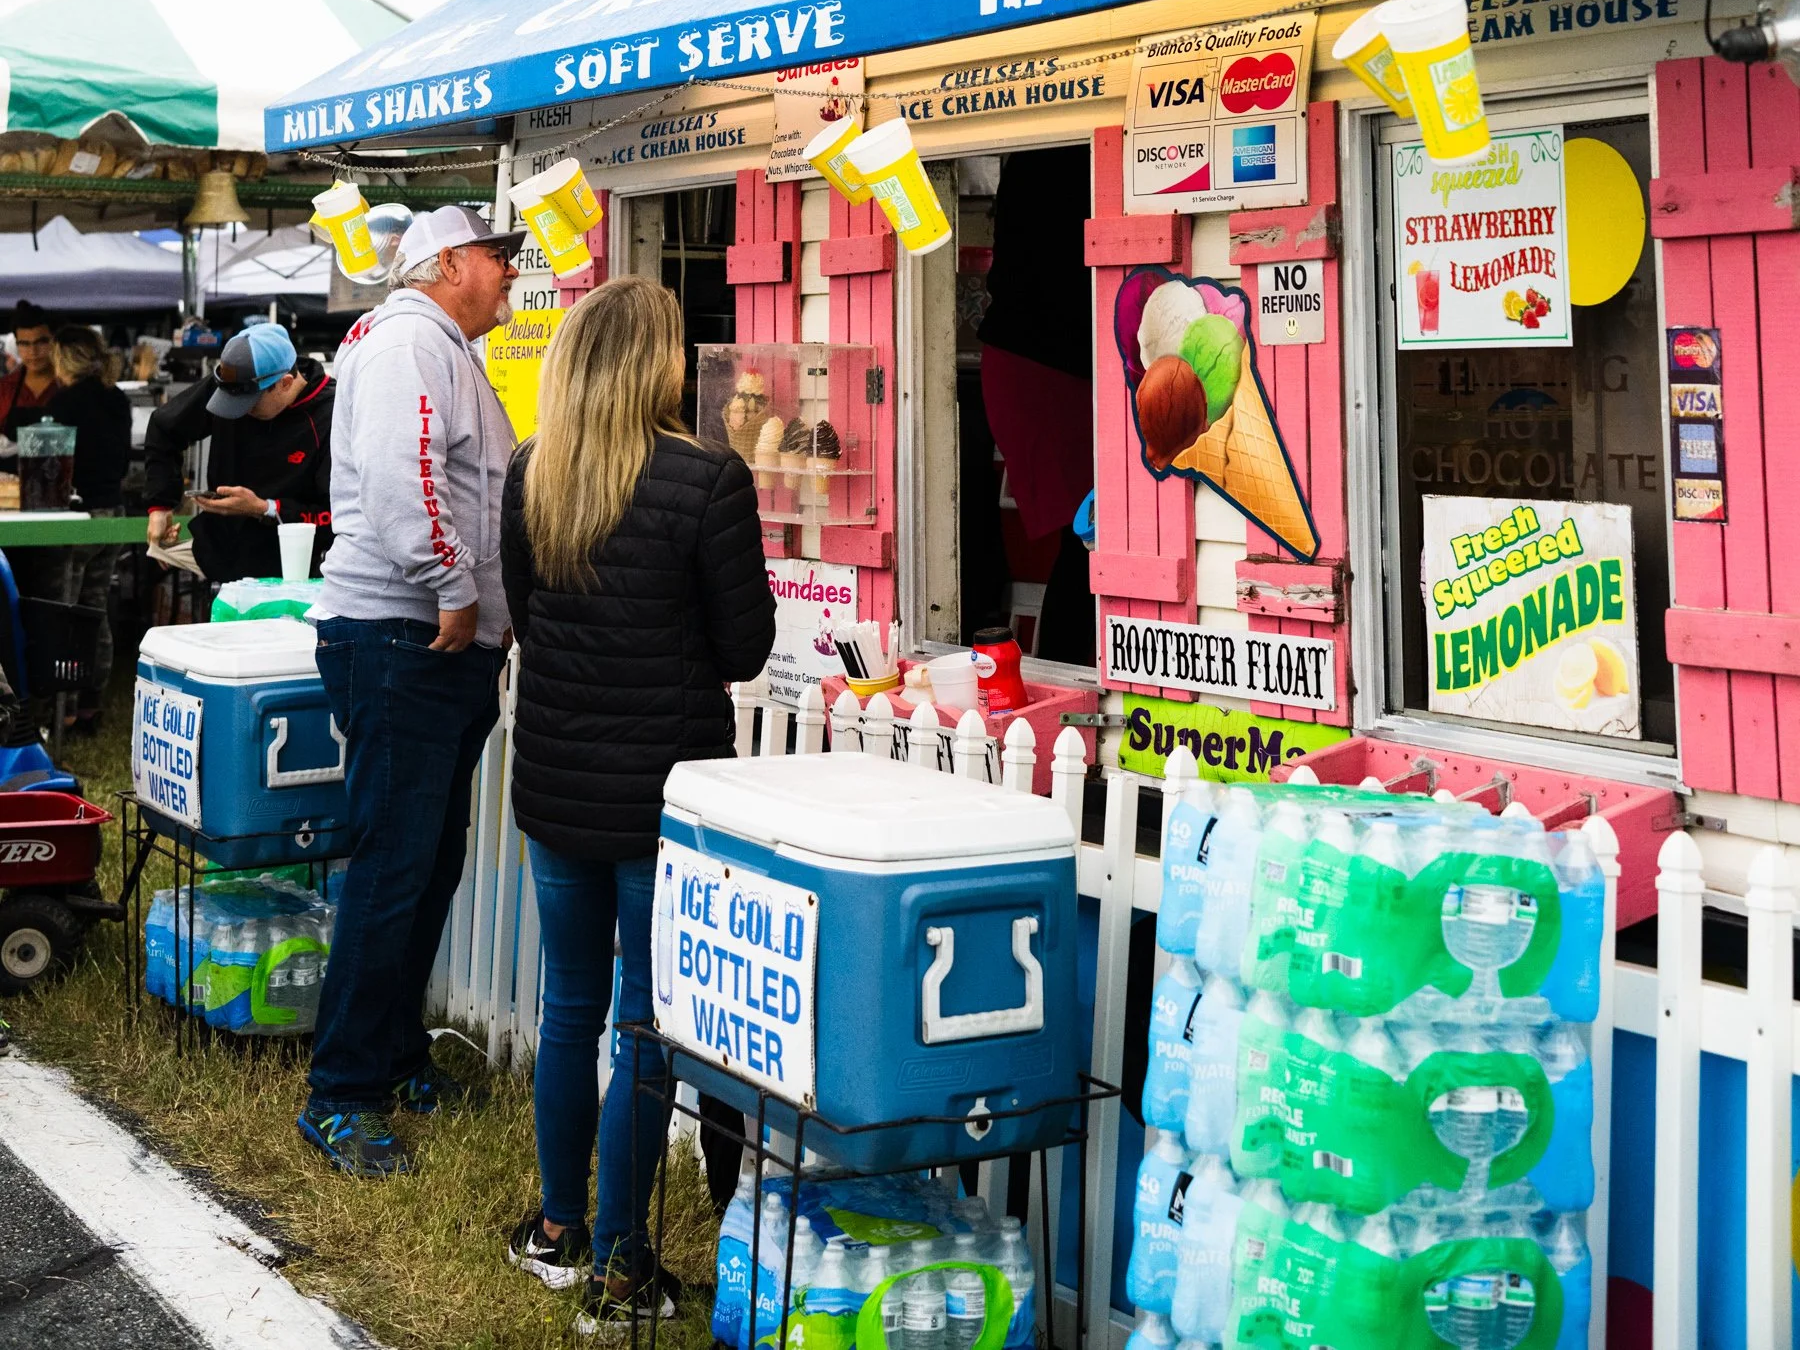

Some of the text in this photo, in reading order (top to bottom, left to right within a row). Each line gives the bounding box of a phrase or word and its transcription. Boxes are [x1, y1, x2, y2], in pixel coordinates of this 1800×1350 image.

[554, 1, 845, 96] SOFT SERVE
[1147, 21, 1303, 59] Bianco's Quality Foods
[940, 56, 1060, 90] CHELSEA'S
[1221, 70, 1296, 96] MasterCard
[283, 69, 493, 143] MILK SHAKES
[942, 86, 1018, 116] CREAM
[1025, 74, 1106, 104] HOUSE
[1146, 77, 1206, 110] VISA
[529, 105, 572, 129] FRESH
[640, 111, 719, 140] CHELSEA'S
[611, 148, 634, 165] ICE
[640, 139, 690, 161] CREAM
[695, 128, 747, 151] HOUSE
[770, 149, 797, 161] Chocolate
[773, 132, 787, 145] Come
[1137, 143, 1206, 164] DISCOVER
[1233, 144, 1274, 156] AMERICAN
[767, 163, 784, 177] Nuts,
[1154, 162, 1188, 171] NETWORK
[1241, 155, 1276, 167] EXPRESS
[1430, 150, 1524, 209] squeezed
[1199, 195, 1217, 204] Service
[1217, 193, 1235, 204] Charge
[1404, 205, 1558, 246] STRAWBERRY
[517, 248, 553, 270] FRES
[1449, 246, 1558, 293] LEMONADE
[1274, 264, 1307, 291] NO
[523, 290, 558, 310] HOT
[1261, 293, 1321, 314] REFUNDS
[504, 316, 553, 341] Chelsea's
[491, 346, 503, 361] ICE
[505, 345, 533, 360] CREAM
[1677, 390, 1719, 412] VISA
[1410, 448, 1657, 493] CHOCOLATE
[1450, 506, 1540, 569] Fresh
[1433, 517, 1584, 620] Squeezed
[1434, 557, 1625, 693] LEMONADE
[768, 665, 795, 683] Chocolate
[769, 652, 797, 666] ome with:
[1111, 623, 1328, 700] ROOTBEER FLOAT
[143, 695, 196, 741] ICE COLD
[142, 731, 193, 780] BOTTLED
[148, 769, 189, 816] WATER
[680, 862, 805, 963] ICE COLD
[679, 929, 802, 1026] BOTTLED
[691, 993, 785, 1083] WATER
